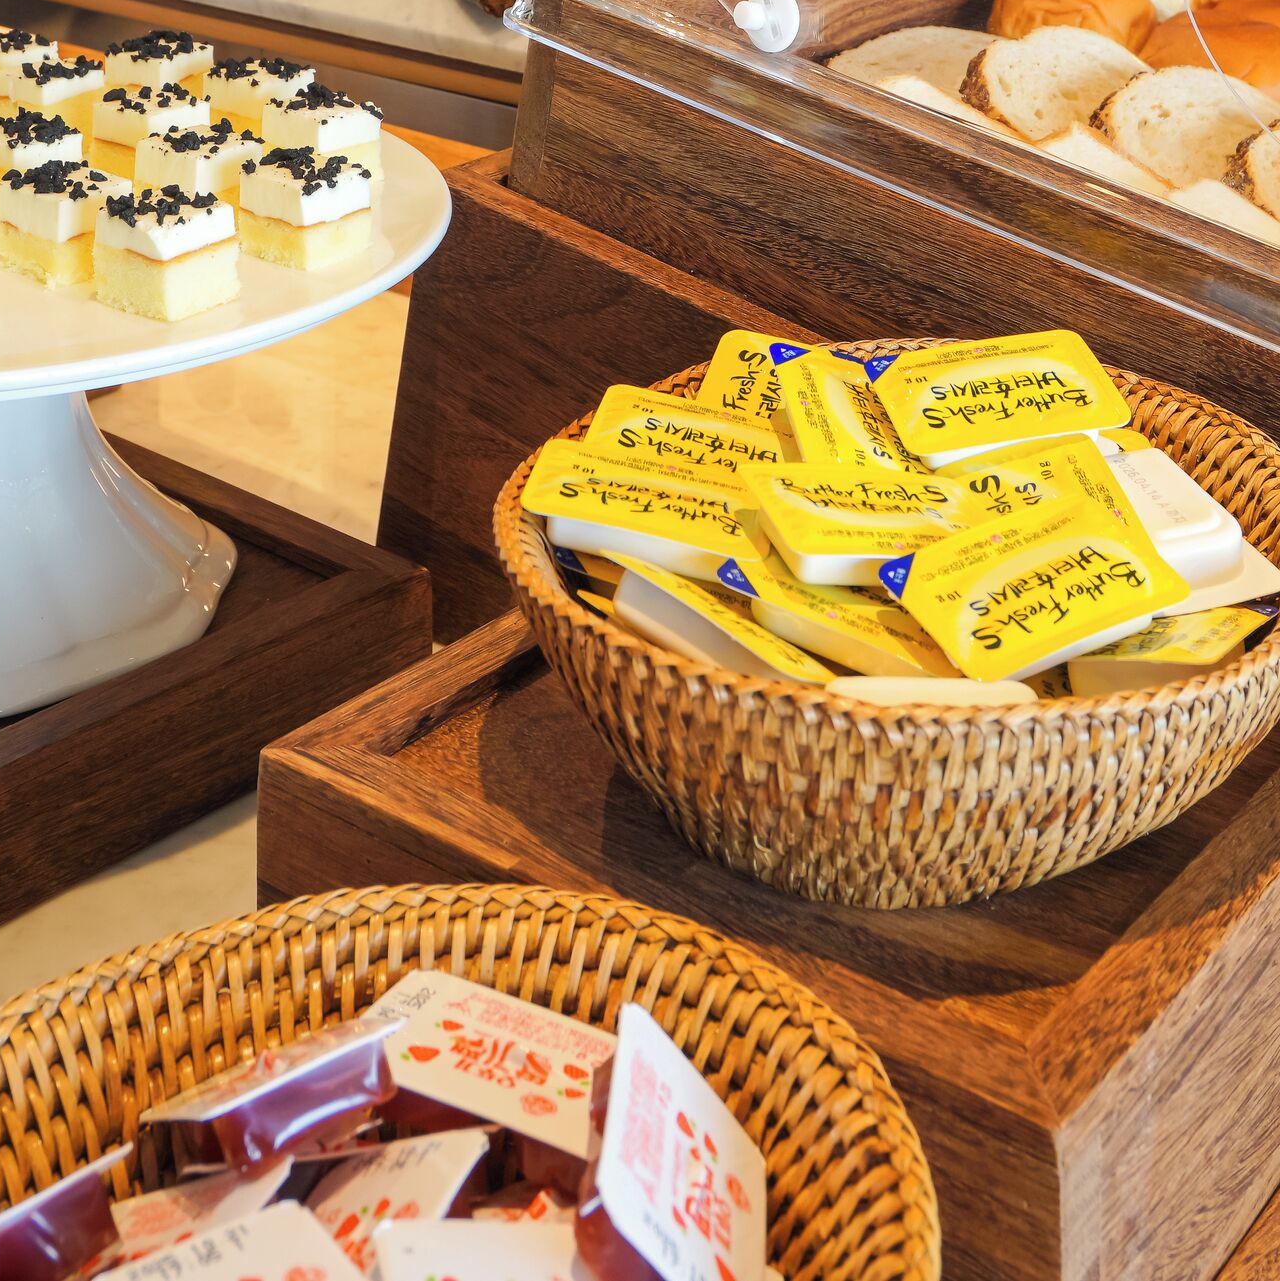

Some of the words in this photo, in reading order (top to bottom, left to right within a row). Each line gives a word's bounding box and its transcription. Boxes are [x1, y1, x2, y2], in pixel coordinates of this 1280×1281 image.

[1016, 388, 1094, 414] Butter
[776, 478, 855, 498] Butter
[662, 500, 743, 536] Butter
[1066, 561, 1146, 602] Butter
